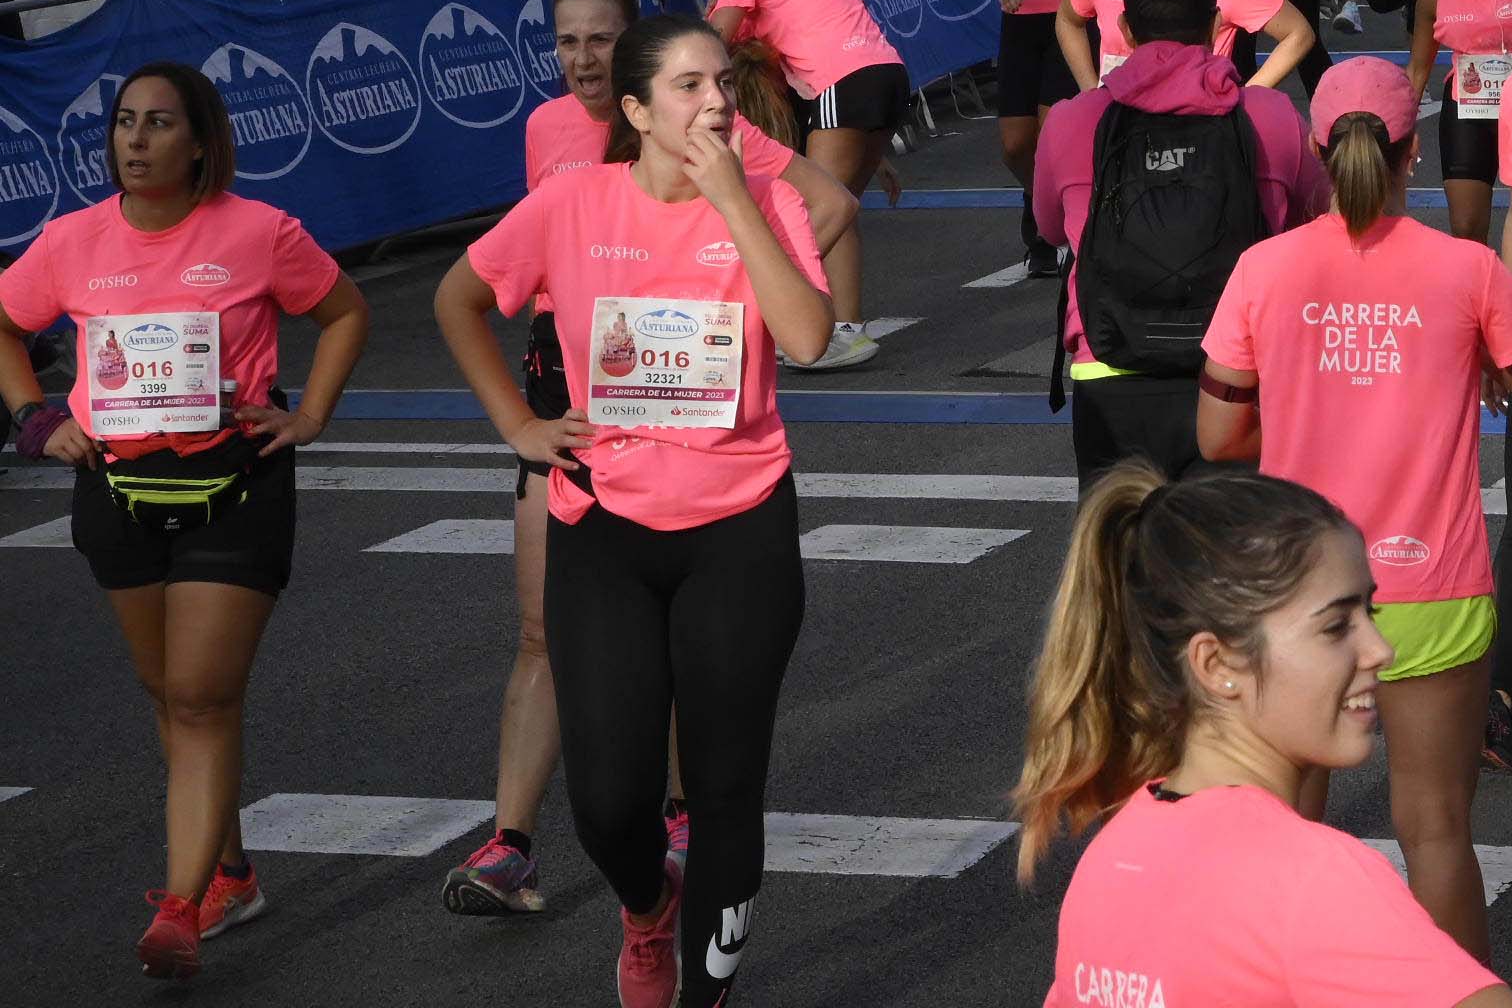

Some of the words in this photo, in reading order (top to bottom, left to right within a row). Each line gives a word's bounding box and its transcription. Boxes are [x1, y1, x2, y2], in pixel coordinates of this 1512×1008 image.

[1444, 14, 1474, 24] OYSHO
[429, 54, 521, 102] ASTURIANA
[1484, 79, 1504, 89] 01
[316, 78, 417, 128] ASTURIANA
[229, 101, 307, 146] TURIANA
[590, 244, 649, 262] OYSHO
[88, 274, 138, 291] OYSHO
[704, 318, 732, 326] SUMA
[1302, 302, 1423, 328] CARRERA
[639, 320, 694, 334] ASTURIANA
[128, 334, 174, 346] ASTURIANA
[1325, 327, 1357, 349] DE
[1368, 327, 1399, 349] LA
[640, 349, 690, 368] 016
[1318, 351, 1401, 374] MUJER
[131, 360, 173, 379] 016
[645, 372, 682, 385] 32321
[1350, 376, 1373, 385] 2023
[140, 383, 167, 394] 3399
[606, 388, 646, 396] CARRERA
[647, 389, 659, 397] DE
[661, 389, 672, 397] LA
[673, 390, 703, 399] MUJER
[704, 391, 725, 399] 2023
[104, 400, 139, 408] CARRERA
[602, 405, 646, 416] OYSHO
[682, 407, 725, 417] Santander
[102, 416, 140, 426] OYSHO
[170, 413, 208, 423] Santander
[1374, 545, 1426, 560] ASTURIANA
[721, 897, 756, 947] NI
[1075, 962, 1166, 1008] CARRERA
